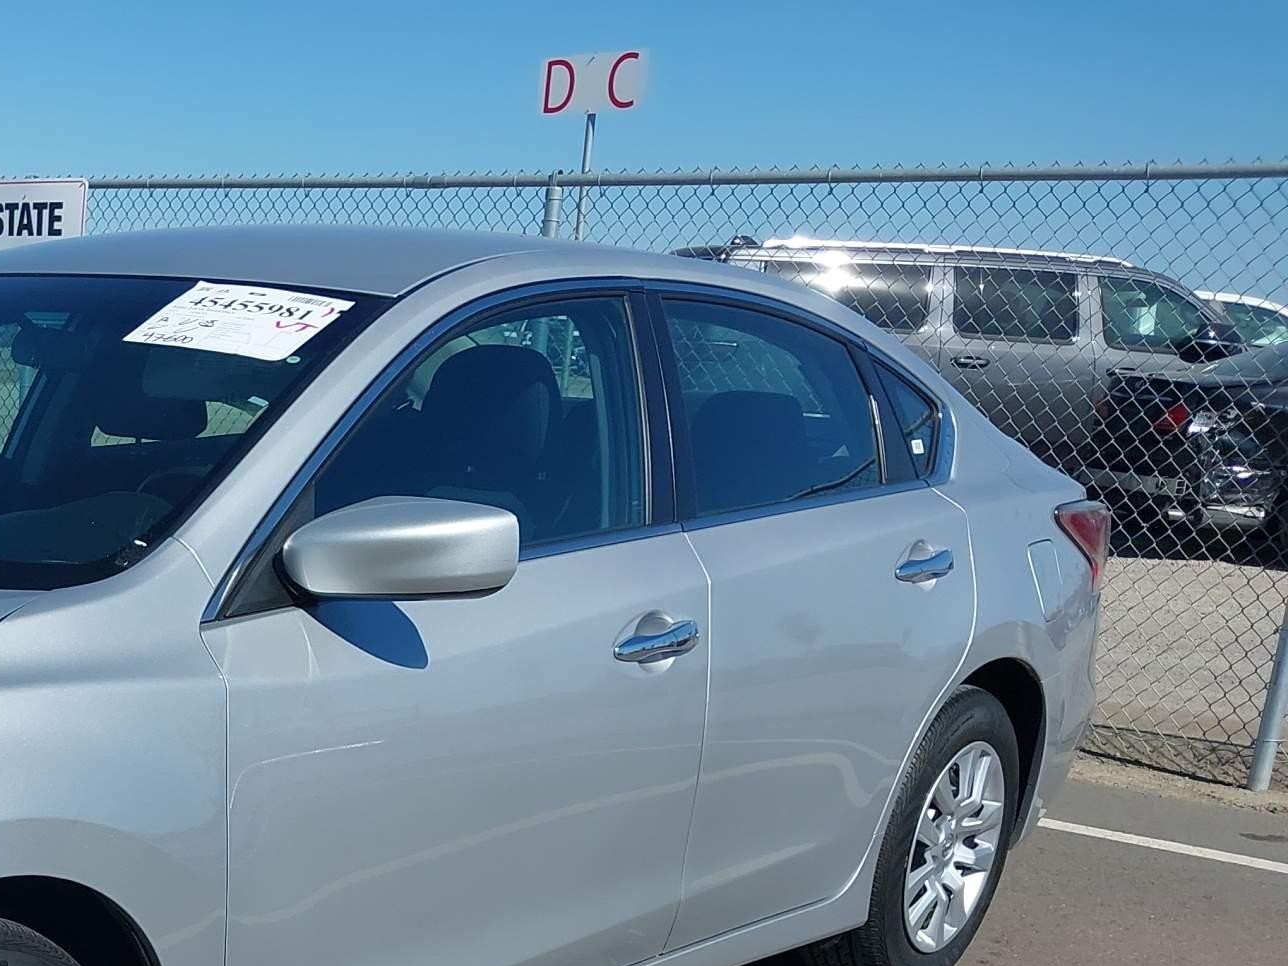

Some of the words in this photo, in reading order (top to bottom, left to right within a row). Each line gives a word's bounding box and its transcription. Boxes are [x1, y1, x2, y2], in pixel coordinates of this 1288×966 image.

[543, 59, 575, 113] D
[608, 52, 640, 108] C
[189, 296, 313, 320] 45455981
